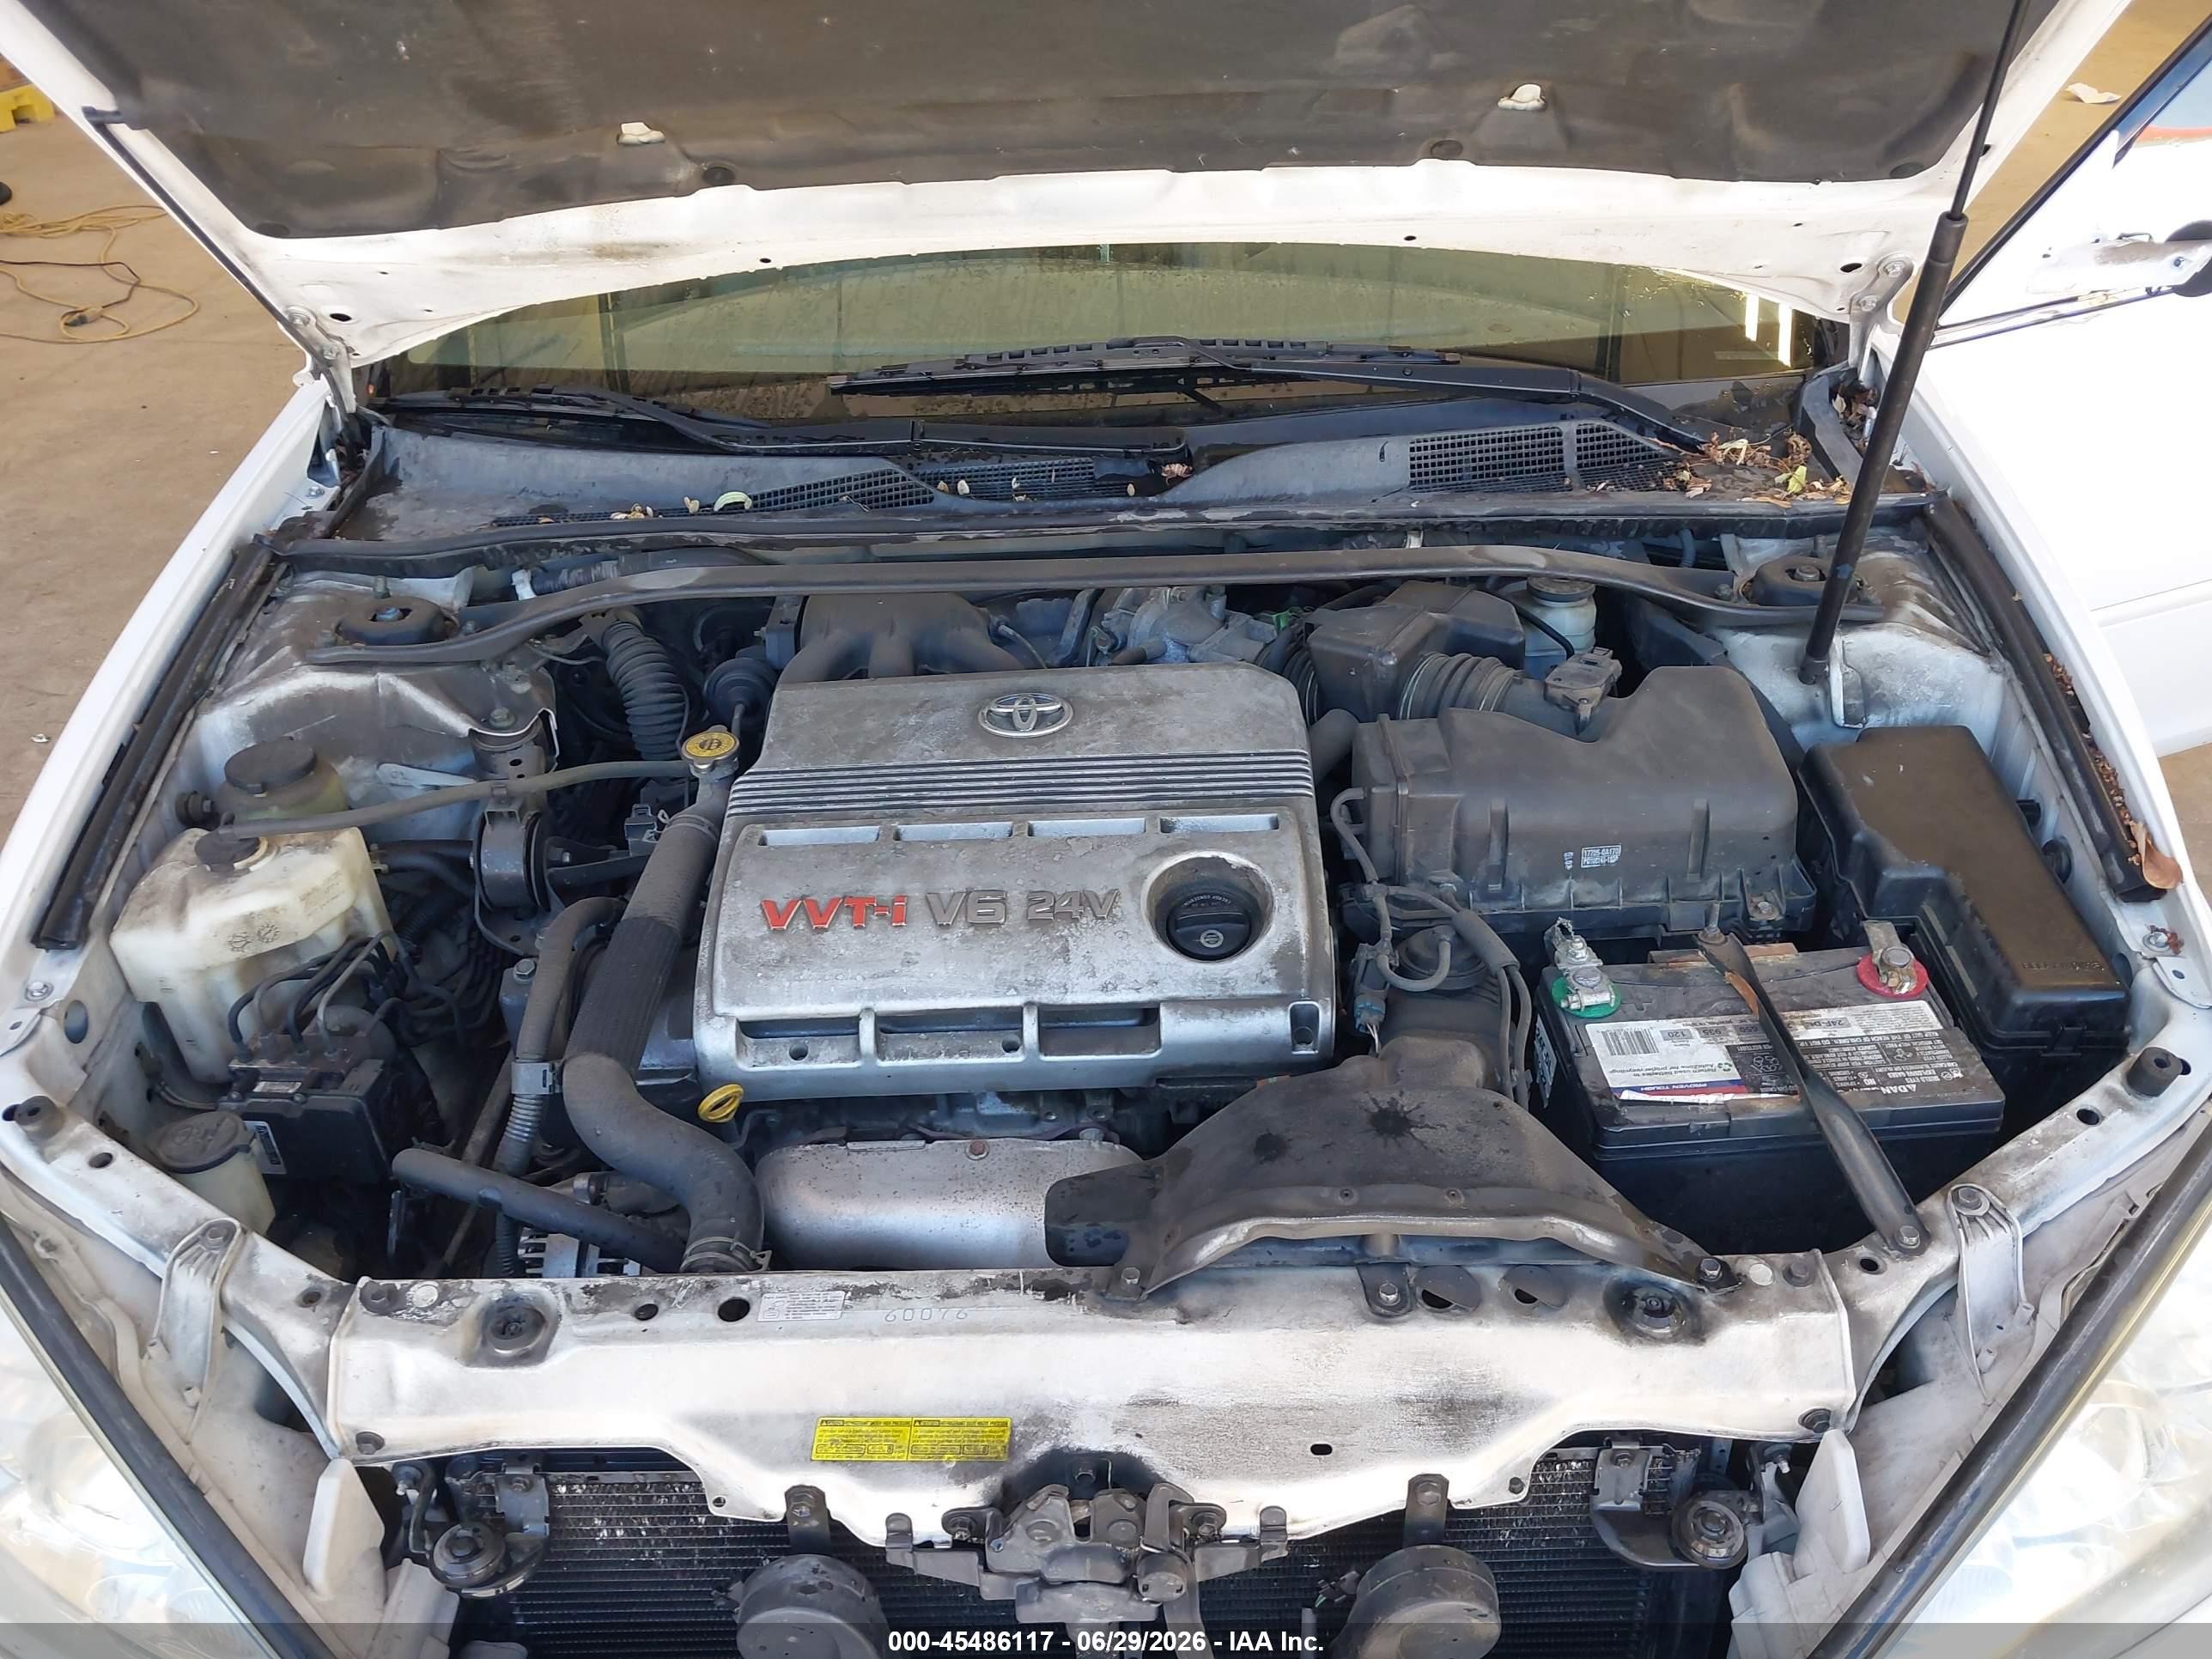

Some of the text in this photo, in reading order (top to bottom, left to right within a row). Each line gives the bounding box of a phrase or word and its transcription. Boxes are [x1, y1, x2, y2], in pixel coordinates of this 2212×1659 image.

[761, 889, 1120, 930] VVT-i V6 24V
